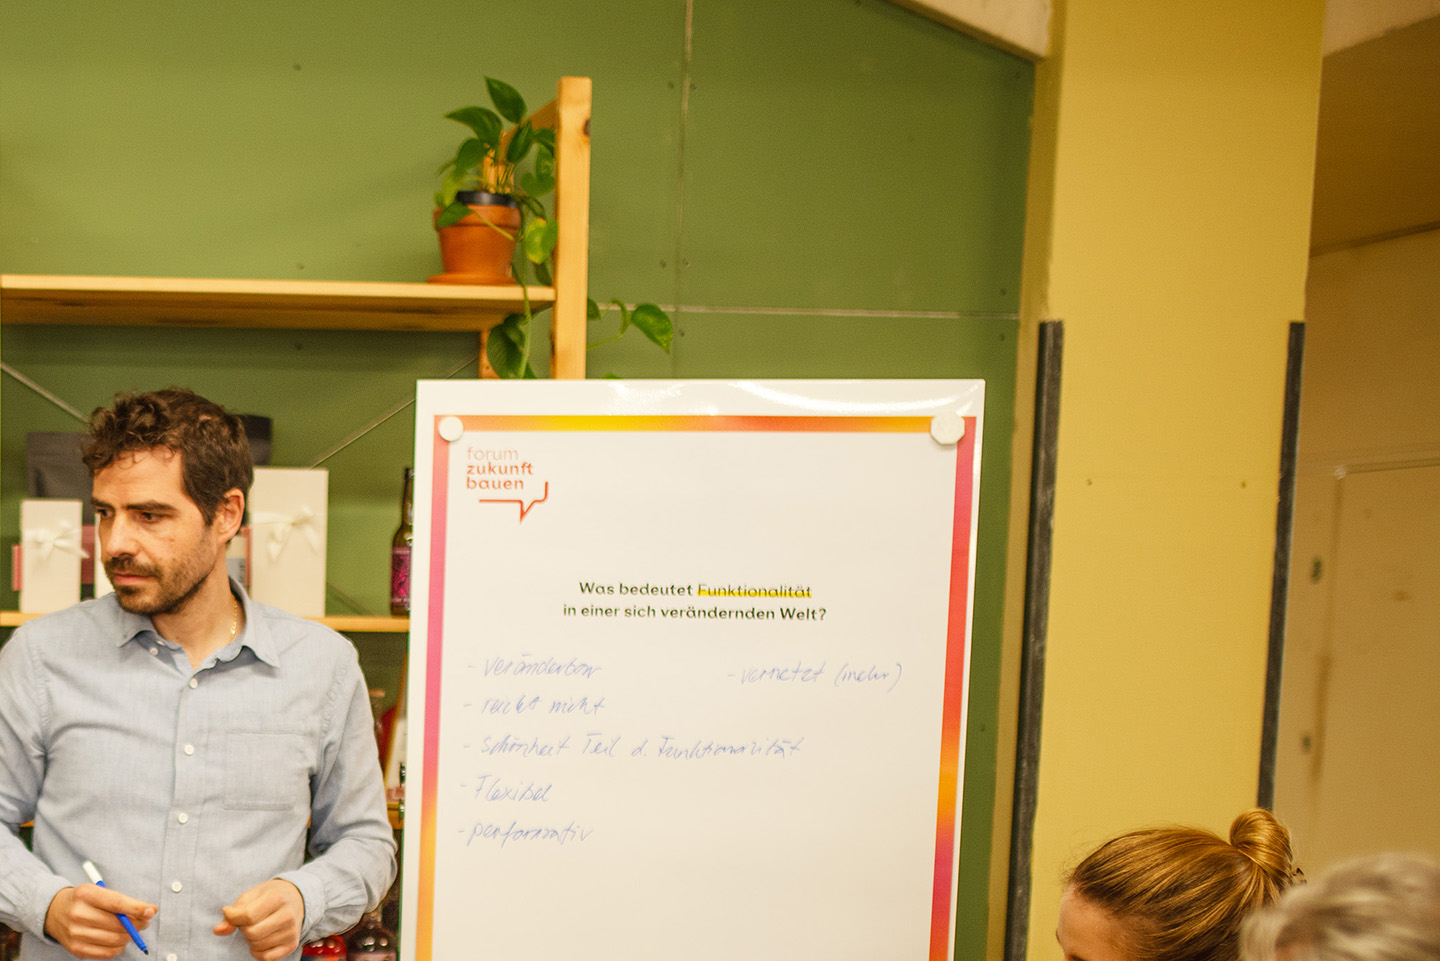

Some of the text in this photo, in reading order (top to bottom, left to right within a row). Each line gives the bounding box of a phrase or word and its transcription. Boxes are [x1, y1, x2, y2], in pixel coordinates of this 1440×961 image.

[467, 447, 519, 461] forum
[467, 462, 534, 475] zukunft
[466, 477, 524, 490] bauen
[579, 581, 813, 598] Was bedeutet Funktionalität
[563, 604, 827, 621] in einer sich verändernden Welt?
